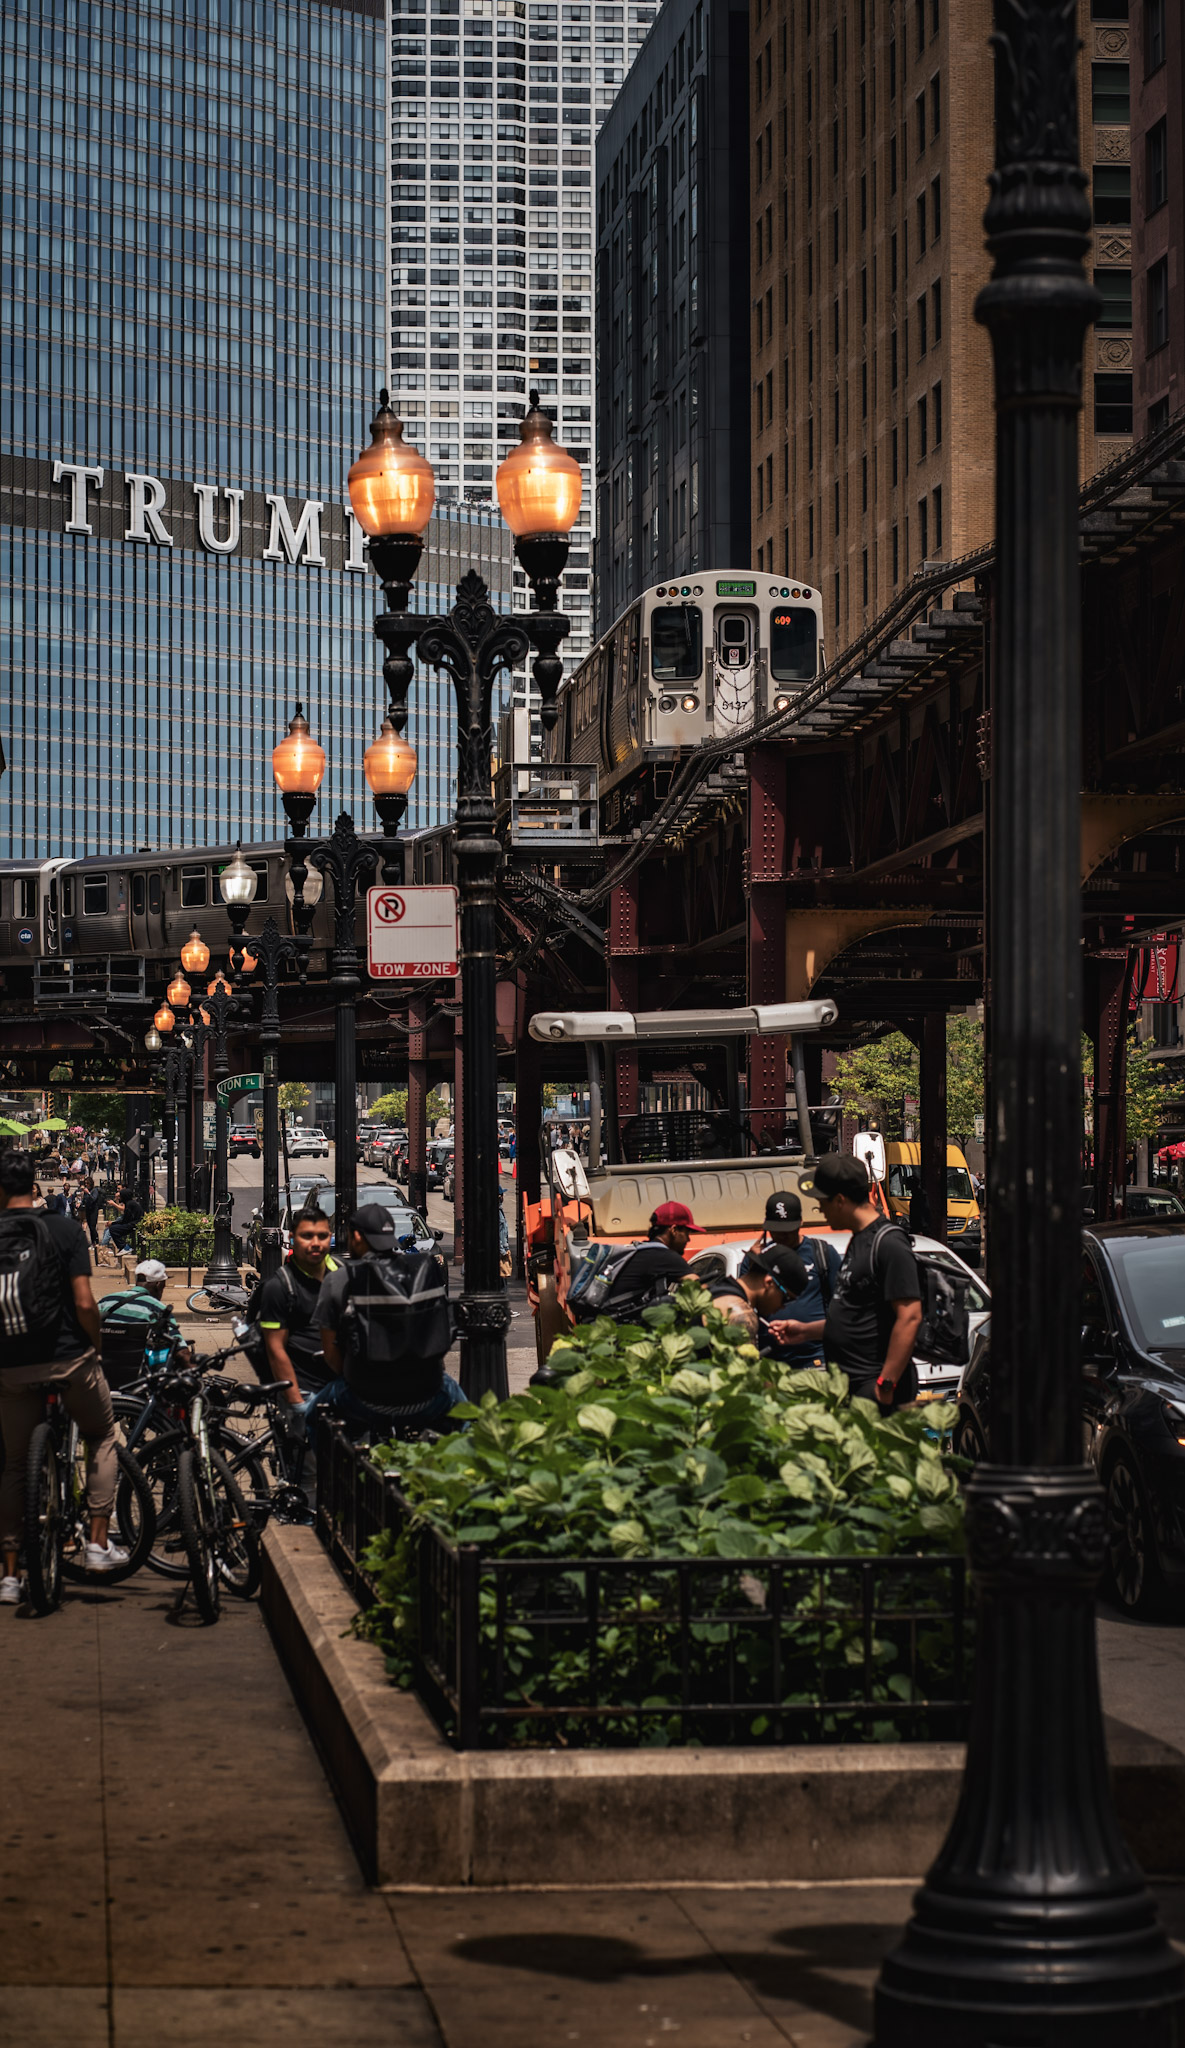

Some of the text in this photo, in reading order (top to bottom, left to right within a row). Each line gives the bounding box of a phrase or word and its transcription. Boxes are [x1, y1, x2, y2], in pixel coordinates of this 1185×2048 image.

[774, 615, 792, 625] 609
[722, 701, 748, 711] 5137
[375, 963, 451, 976] TOW ZONE
